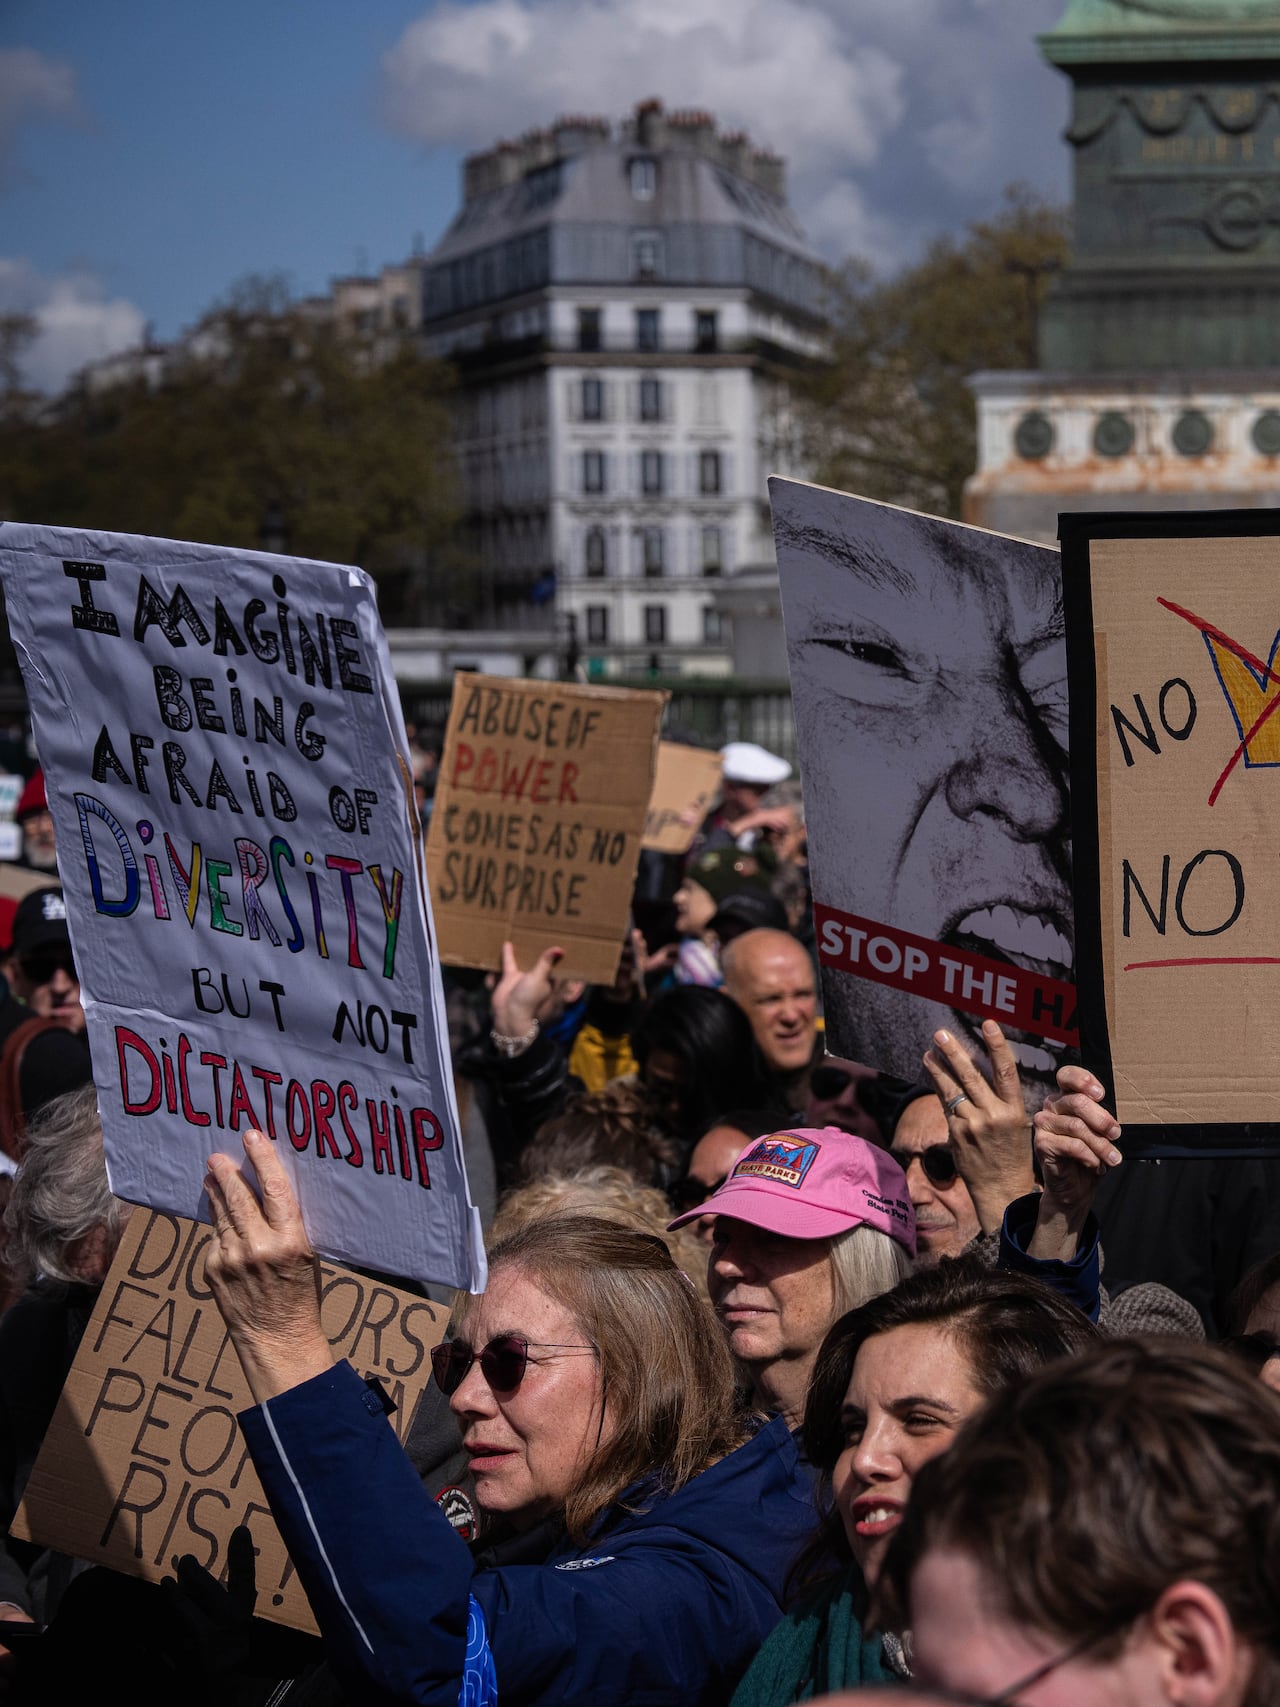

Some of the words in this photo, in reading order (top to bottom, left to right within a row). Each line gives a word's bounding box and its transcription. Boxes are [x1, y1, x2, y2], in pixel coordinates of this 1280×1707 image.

[458, 686, 566, 748] ABUSE
[566, 710, 602, 747] OF
[1110, 677, 1197, 767] NO
[451, 743, 580, 806] POWER
[328, 785, 378, 836] OF
[444, 804, 543, 856] COMES
[543, 820, 583, 860] AS
[589, 830, 626, 866] NO
[439, 851, 589, 916] SURPRISE
[1122, 849, 1245, 938] NO
[820, 919, 930, 980] STOP
[940, 956, 1017, 1013] THE
[191, 967, 287, 1032] BUT
[332, 1000, 418, 1064] NOT
[764, 1165, 797, 1181] PARKS
